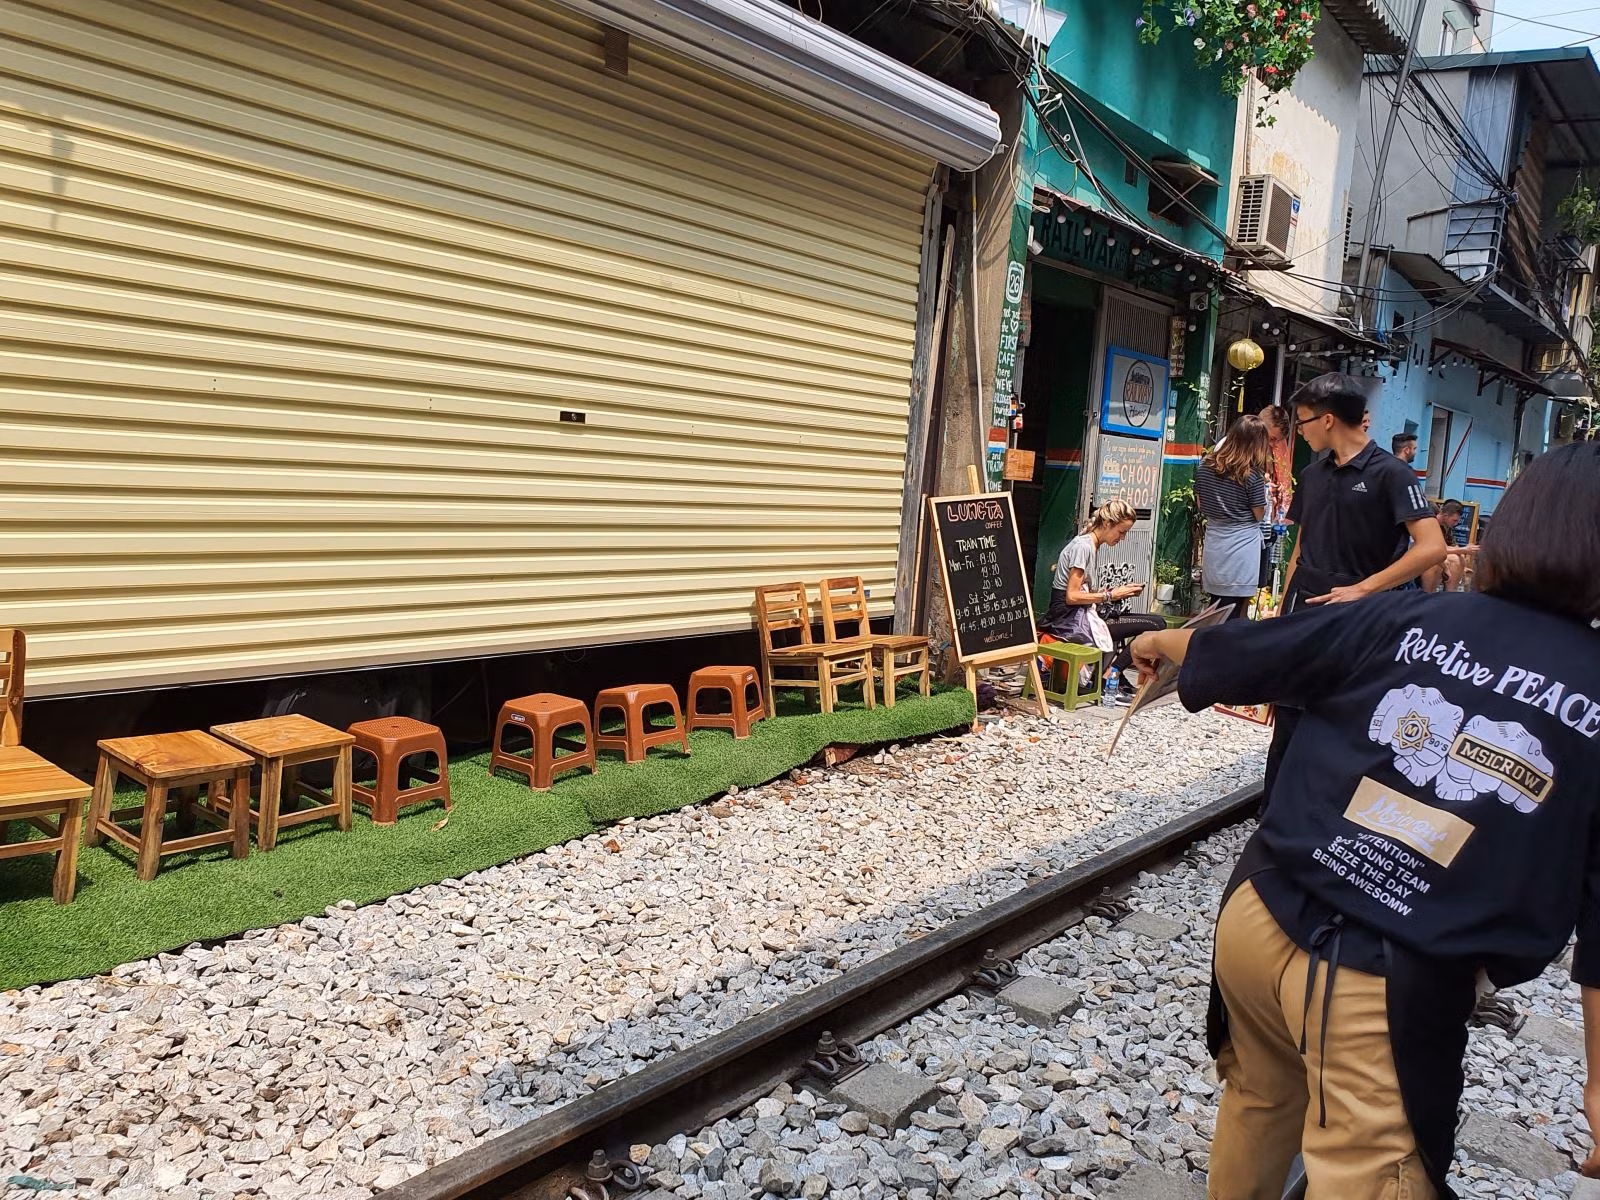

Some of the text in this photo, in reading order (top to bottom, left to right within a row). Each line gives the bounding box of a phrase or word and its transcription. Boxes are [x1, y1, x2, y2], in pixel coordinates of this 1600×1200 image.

[1010, 273, 1020, 294] 26
[998, 351, 1015, 367] CAFE
[947, 500, 1004, 522] LUNGTA
[985, 521, 1003, 530] COFFEE
[956, 534, 997, 552] TRAIN TIME
[1395, 627, 1600, 738] Relative PEACE
[1327, 840, 1413, 900] SEIZE THE DAY
[1352, 840, 1395, 872] YOUNG
[1394, 865, 1431, 894] TEAM
[1312, 848, 1413, 917] BEING AWESOMW
